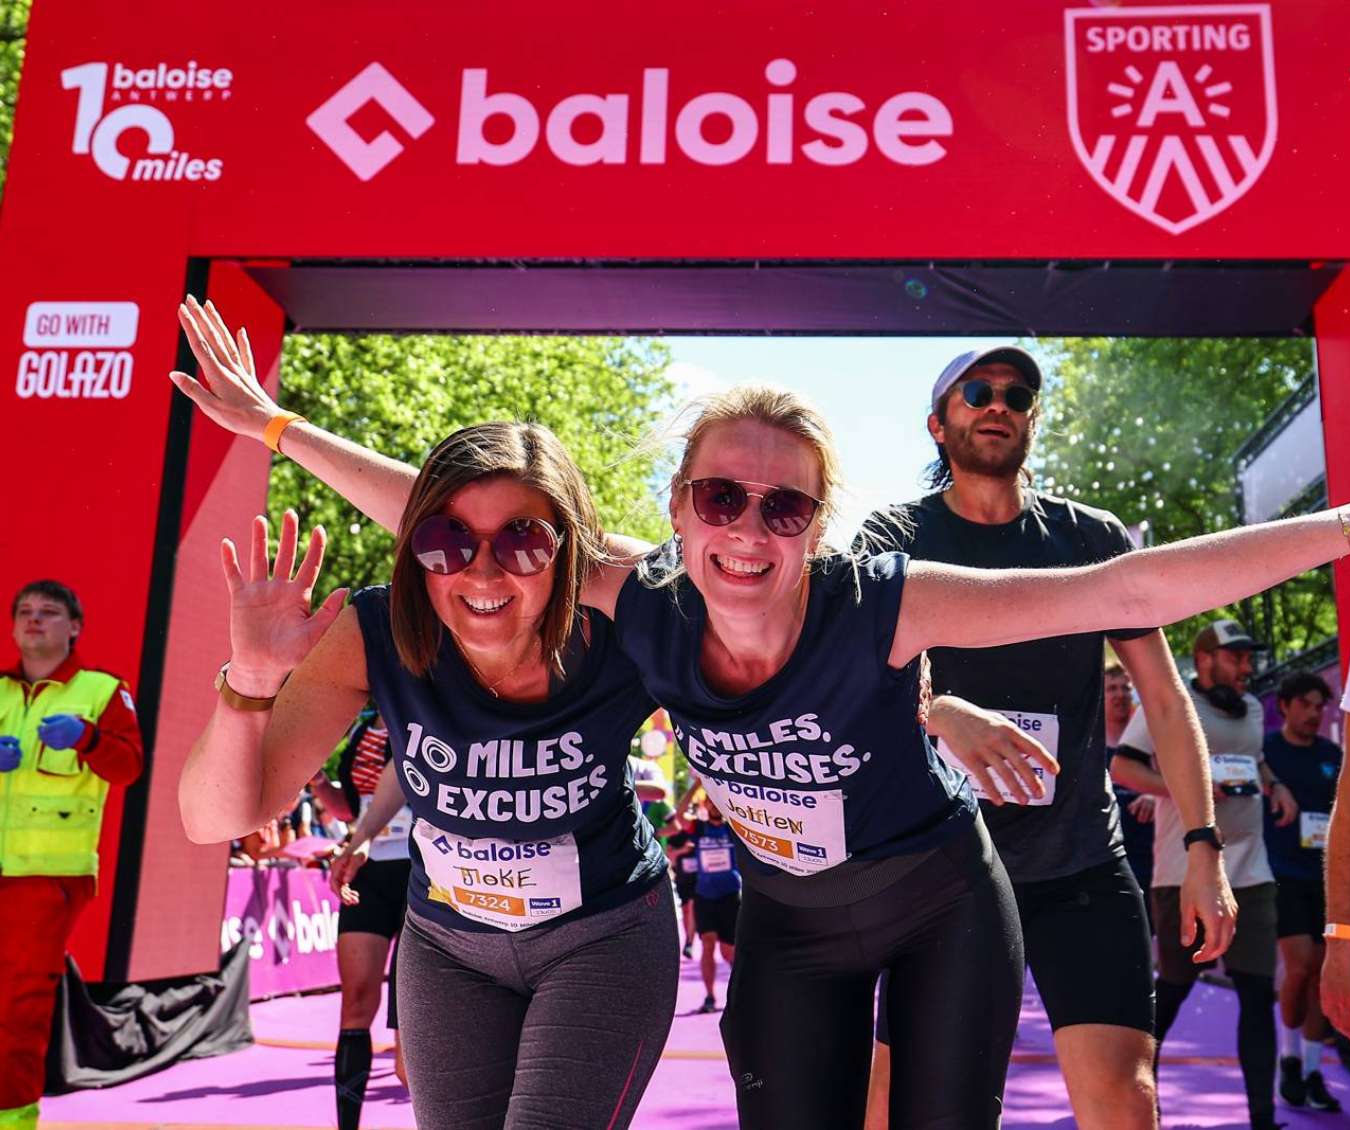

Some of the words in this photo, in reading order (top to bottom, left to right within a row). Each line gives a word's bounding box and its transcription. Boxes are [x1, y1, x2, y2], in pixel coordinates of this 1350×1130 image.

[1086, 24, 1251, 53] SPORTING
[112, 60, 233, 89] baloise
[111, 91, 232, 101] ANTWERP
[61, 61, 174, 181] 10
[456, 58, 953, 166] baloise
[131, 150, 223, 181] miles
[36, 313, 61, 336] GO
[66, 314, 111, 336] WITH
[15, 350, 134, 399] GOLAZO
[701, 713, 832, 751] MILES.
[466, 731, 595, 778] MILES.
[688, 744, 872, 784] EXCUSES.
[728, 781, 818, 809] baloise
[457, 839, 552, 862] baloise
[465, 893, 511, 912] 7324
